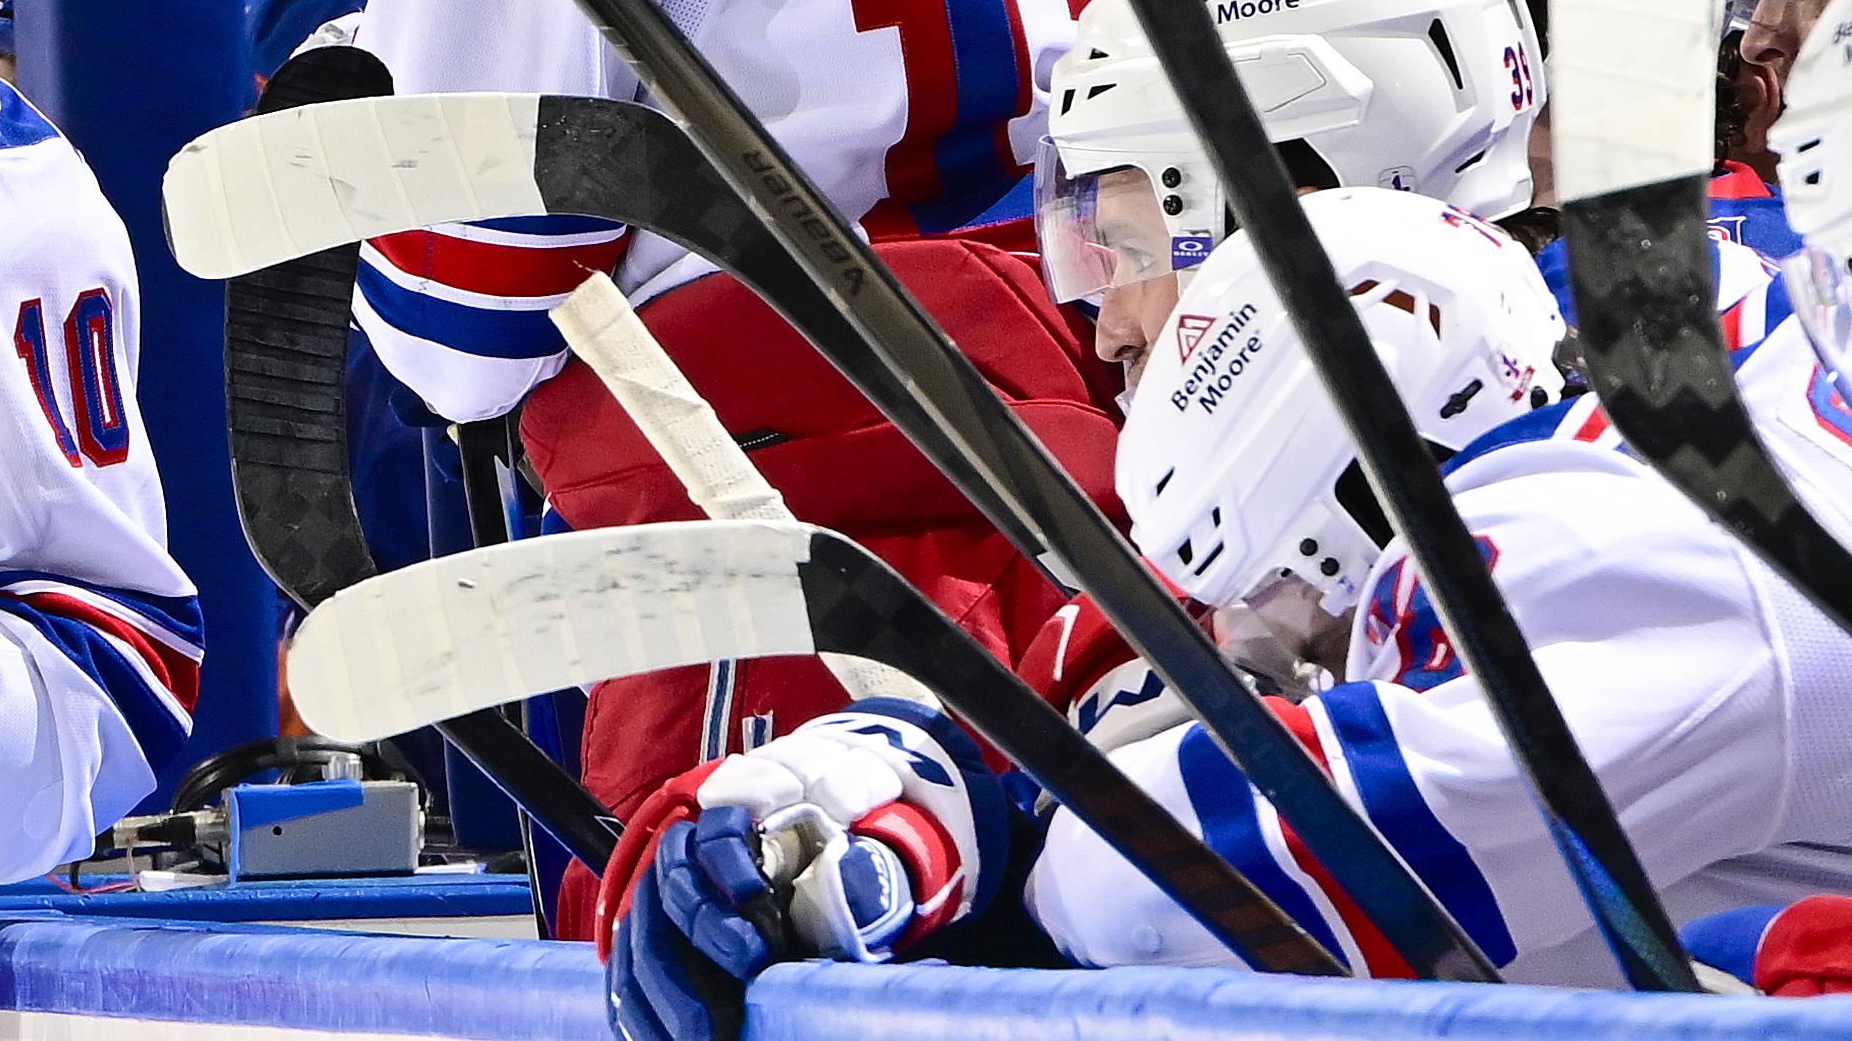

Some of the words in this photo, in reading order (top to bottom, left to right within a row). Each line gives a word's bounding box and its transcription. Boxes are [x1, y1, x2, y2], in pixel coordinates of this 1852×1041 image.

[15, 288, 130, 468] 10
[1171, 303, 1258, 412] Benjamin
[1198, 335, 1263, 415] Moore
